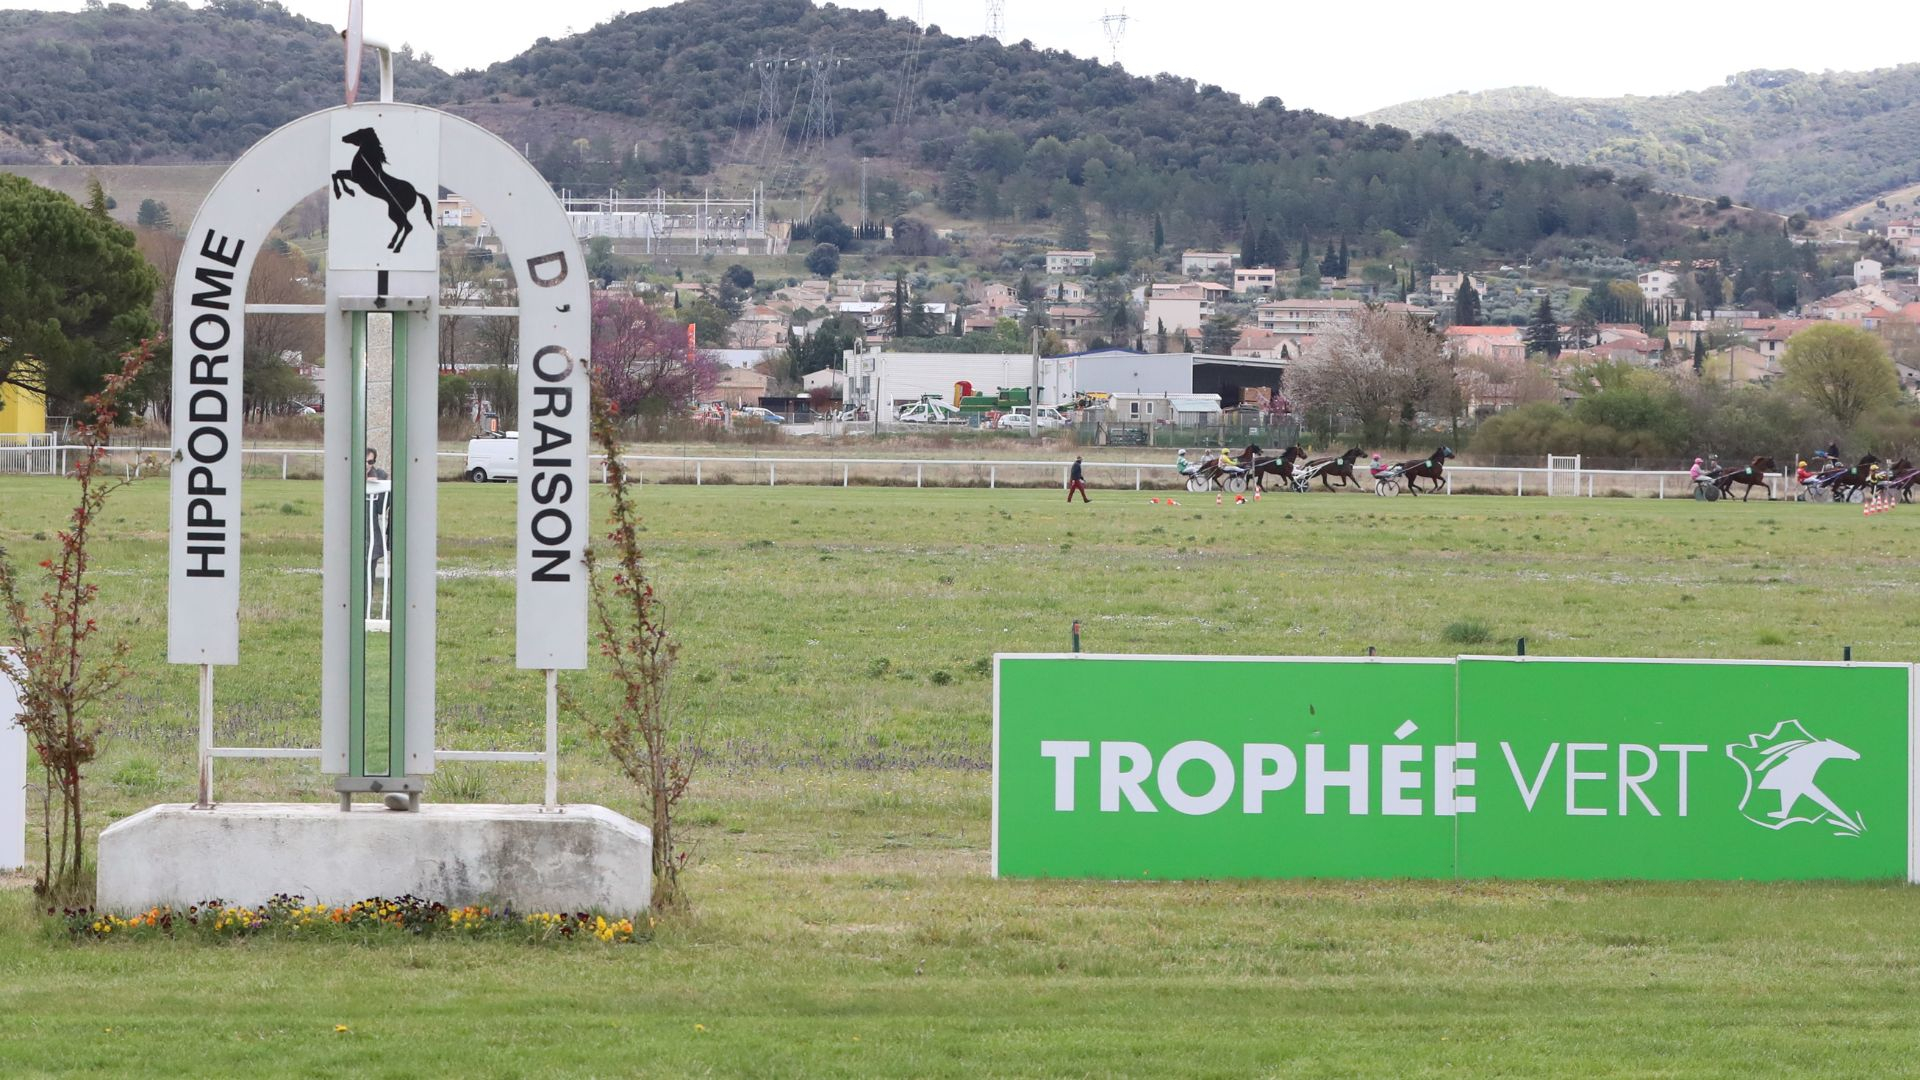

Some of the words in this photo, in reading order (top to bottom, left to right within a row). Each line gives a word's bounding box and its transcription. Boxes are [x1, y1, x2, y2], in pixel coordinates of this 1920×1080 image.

[186, 228, 245, 578] HIPPODROME
[1040, 719, 1477, 816] TROPHÉE
[1500, 741, 1708, 817] VERT
